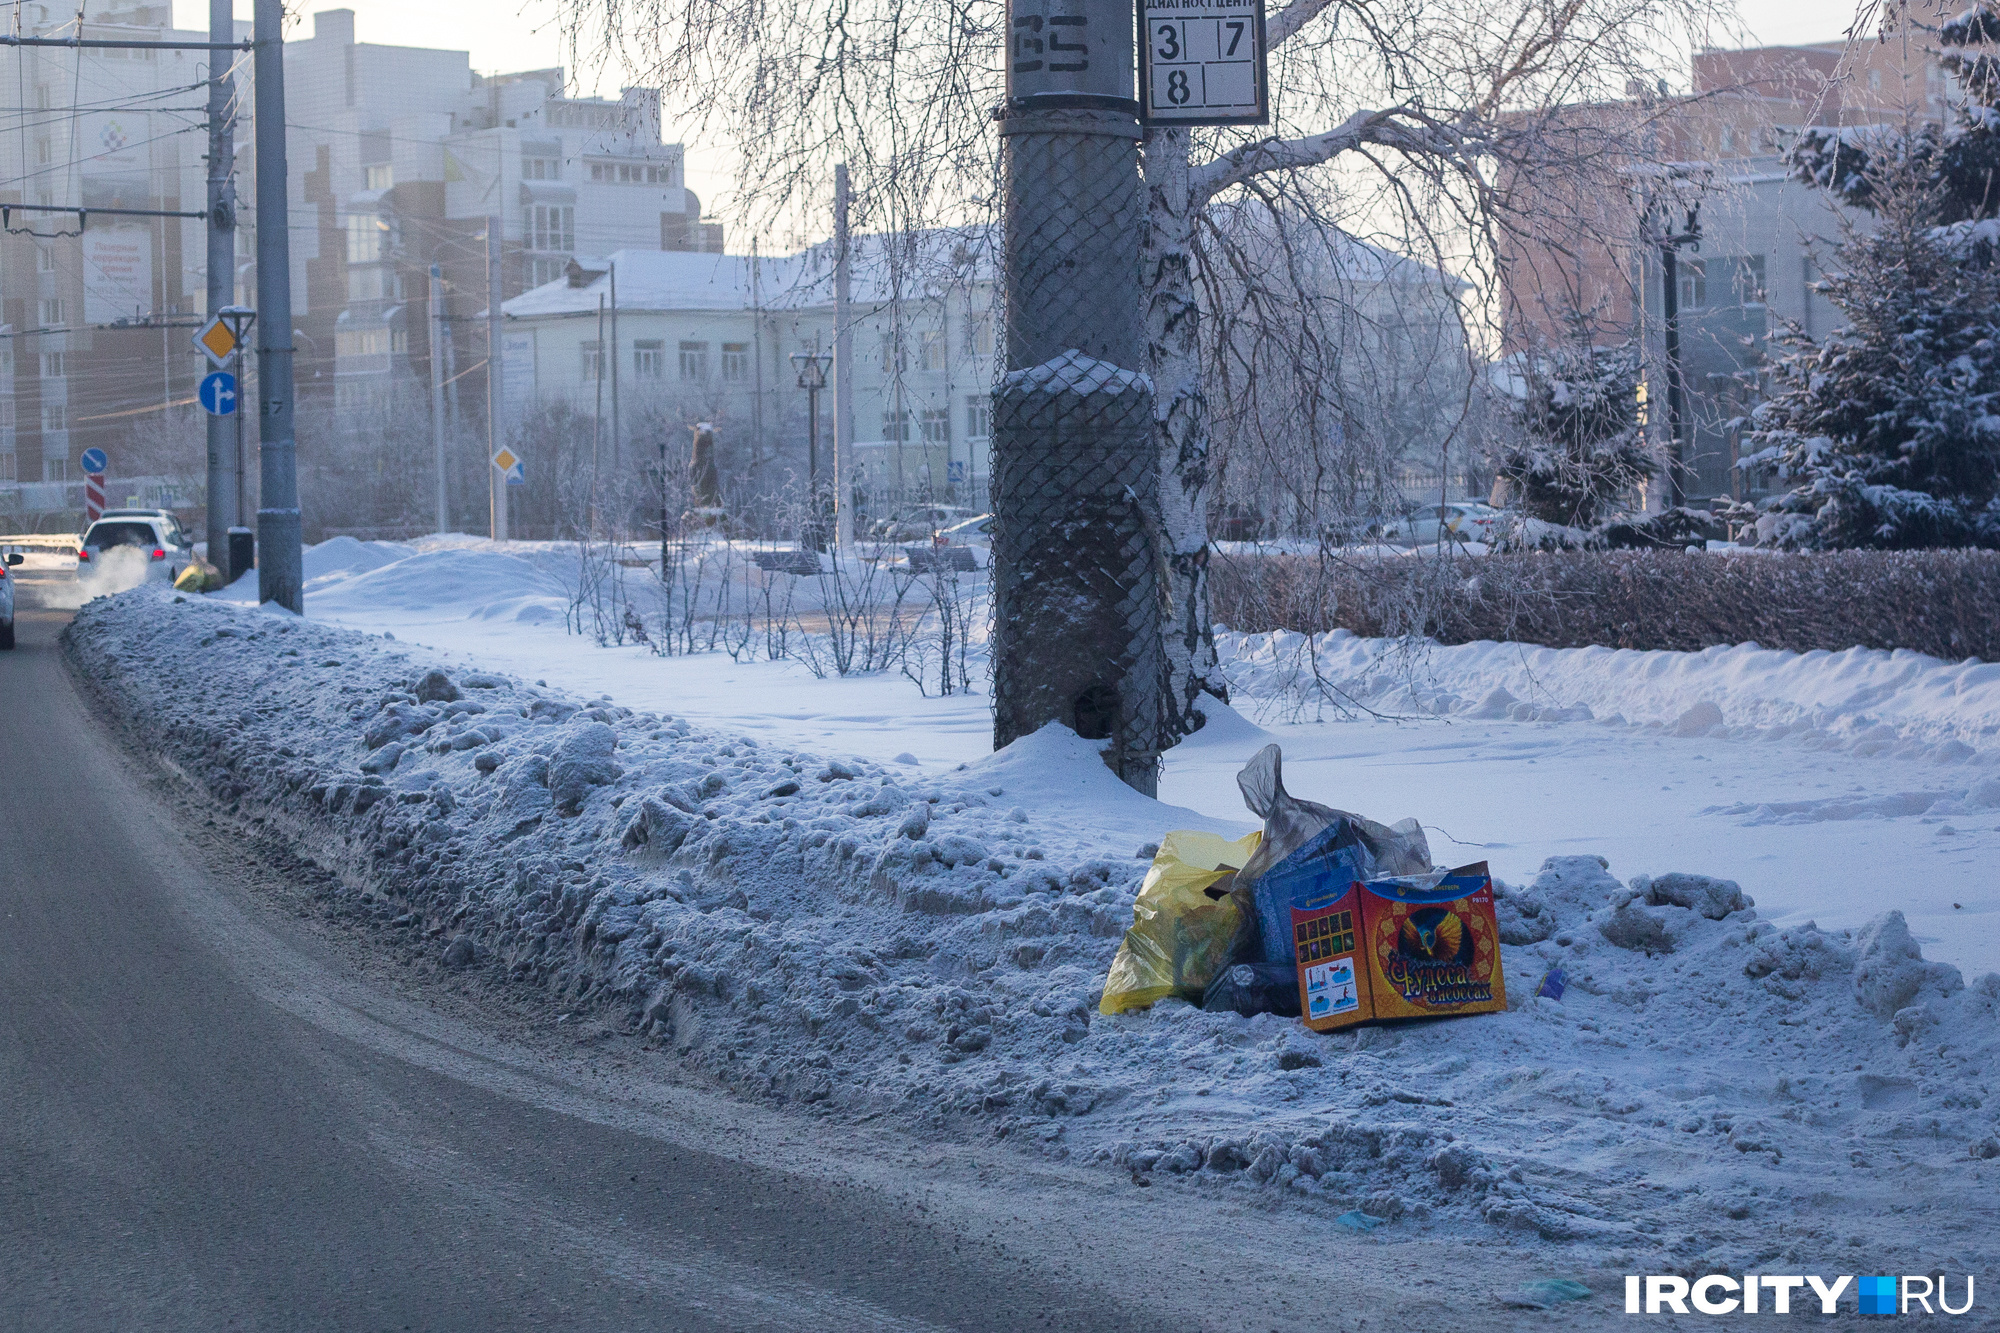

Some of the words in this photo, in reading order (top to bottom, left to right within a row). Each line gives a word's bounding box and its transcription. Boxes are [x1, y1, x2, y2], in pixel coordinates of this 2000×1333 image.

[1157, 24, 1180, 60] 3
[1225, 21, 1244, 56] 7
[1167, 70, 1190, 105] 8
[1391, 960, 1467, 996] Чудеса
[1438, 985, 1490, 1002] небесах
